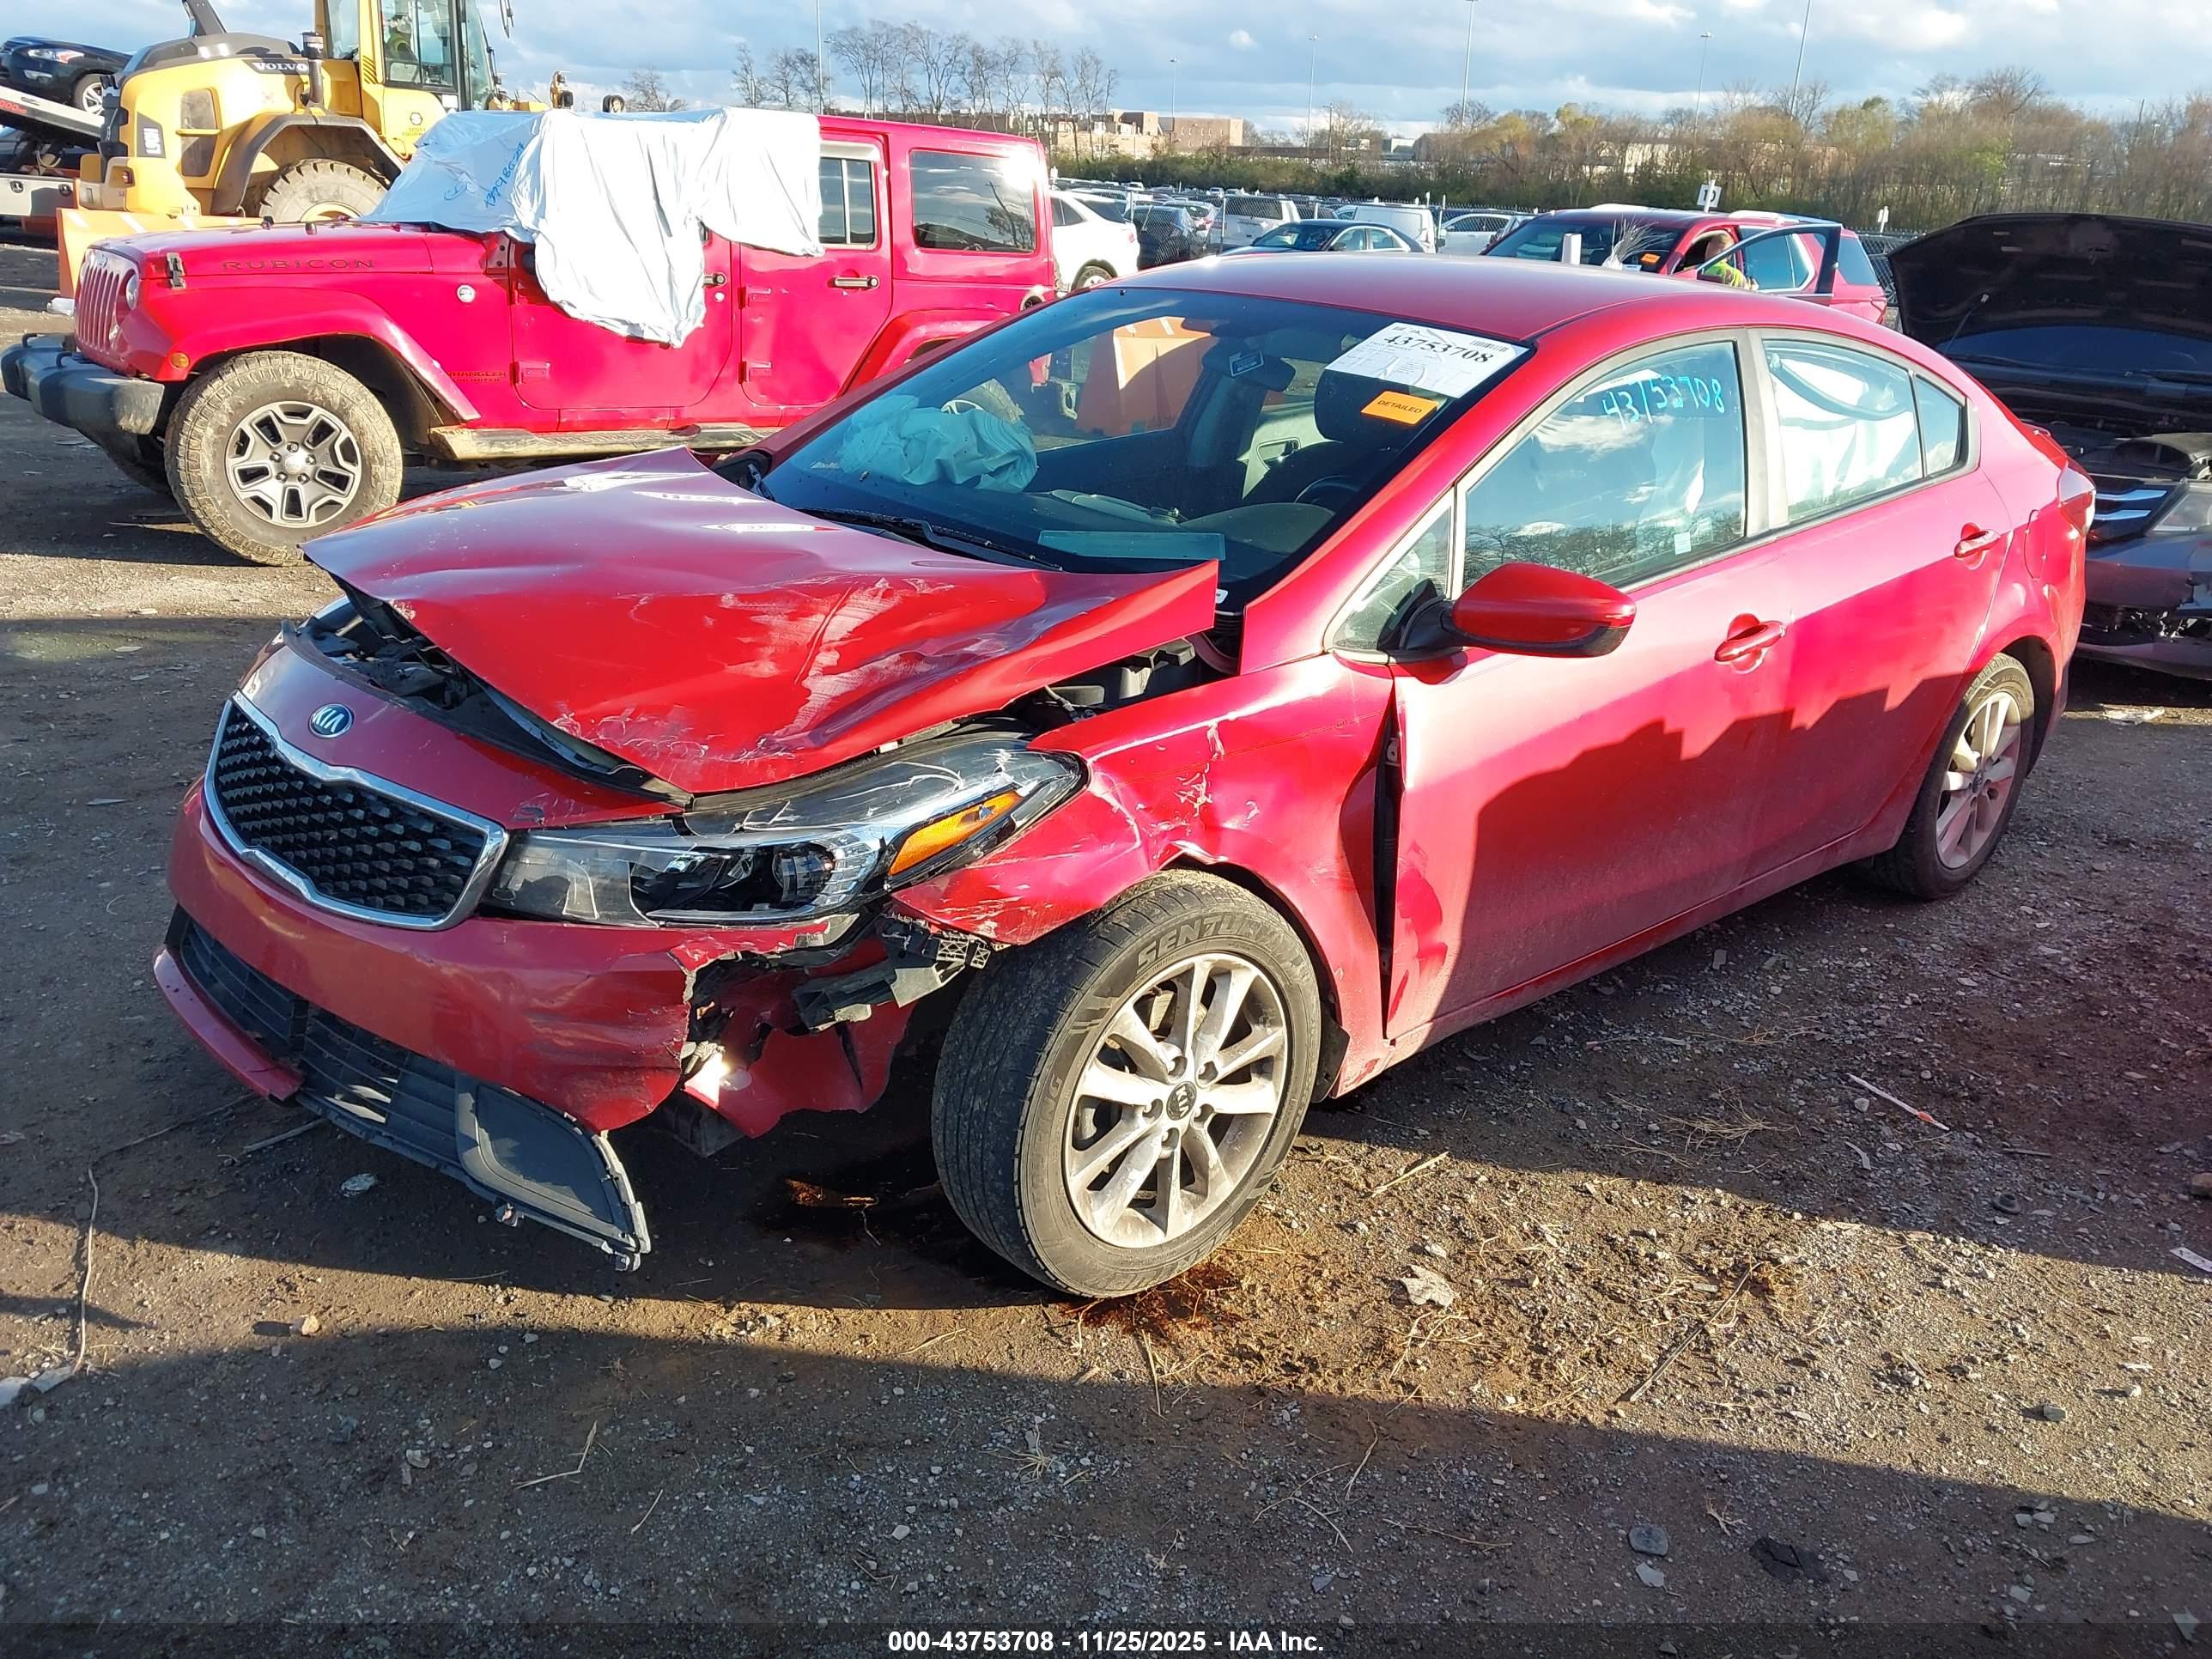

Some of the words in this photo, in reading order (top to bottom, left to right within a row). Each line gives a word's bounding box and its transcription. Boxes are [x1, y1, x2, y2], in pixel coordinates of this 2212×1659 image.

[252, 61, 309, 71] VOLVO
[222, 259, 375, 270] RUBICON
[1382, 333, 1495, 364] 43753708
[1376, 398, 1423, 415] DETAILED
[313, 707, 345, 732] KIA
[1176, 1085, 1189, 1118] KIA
